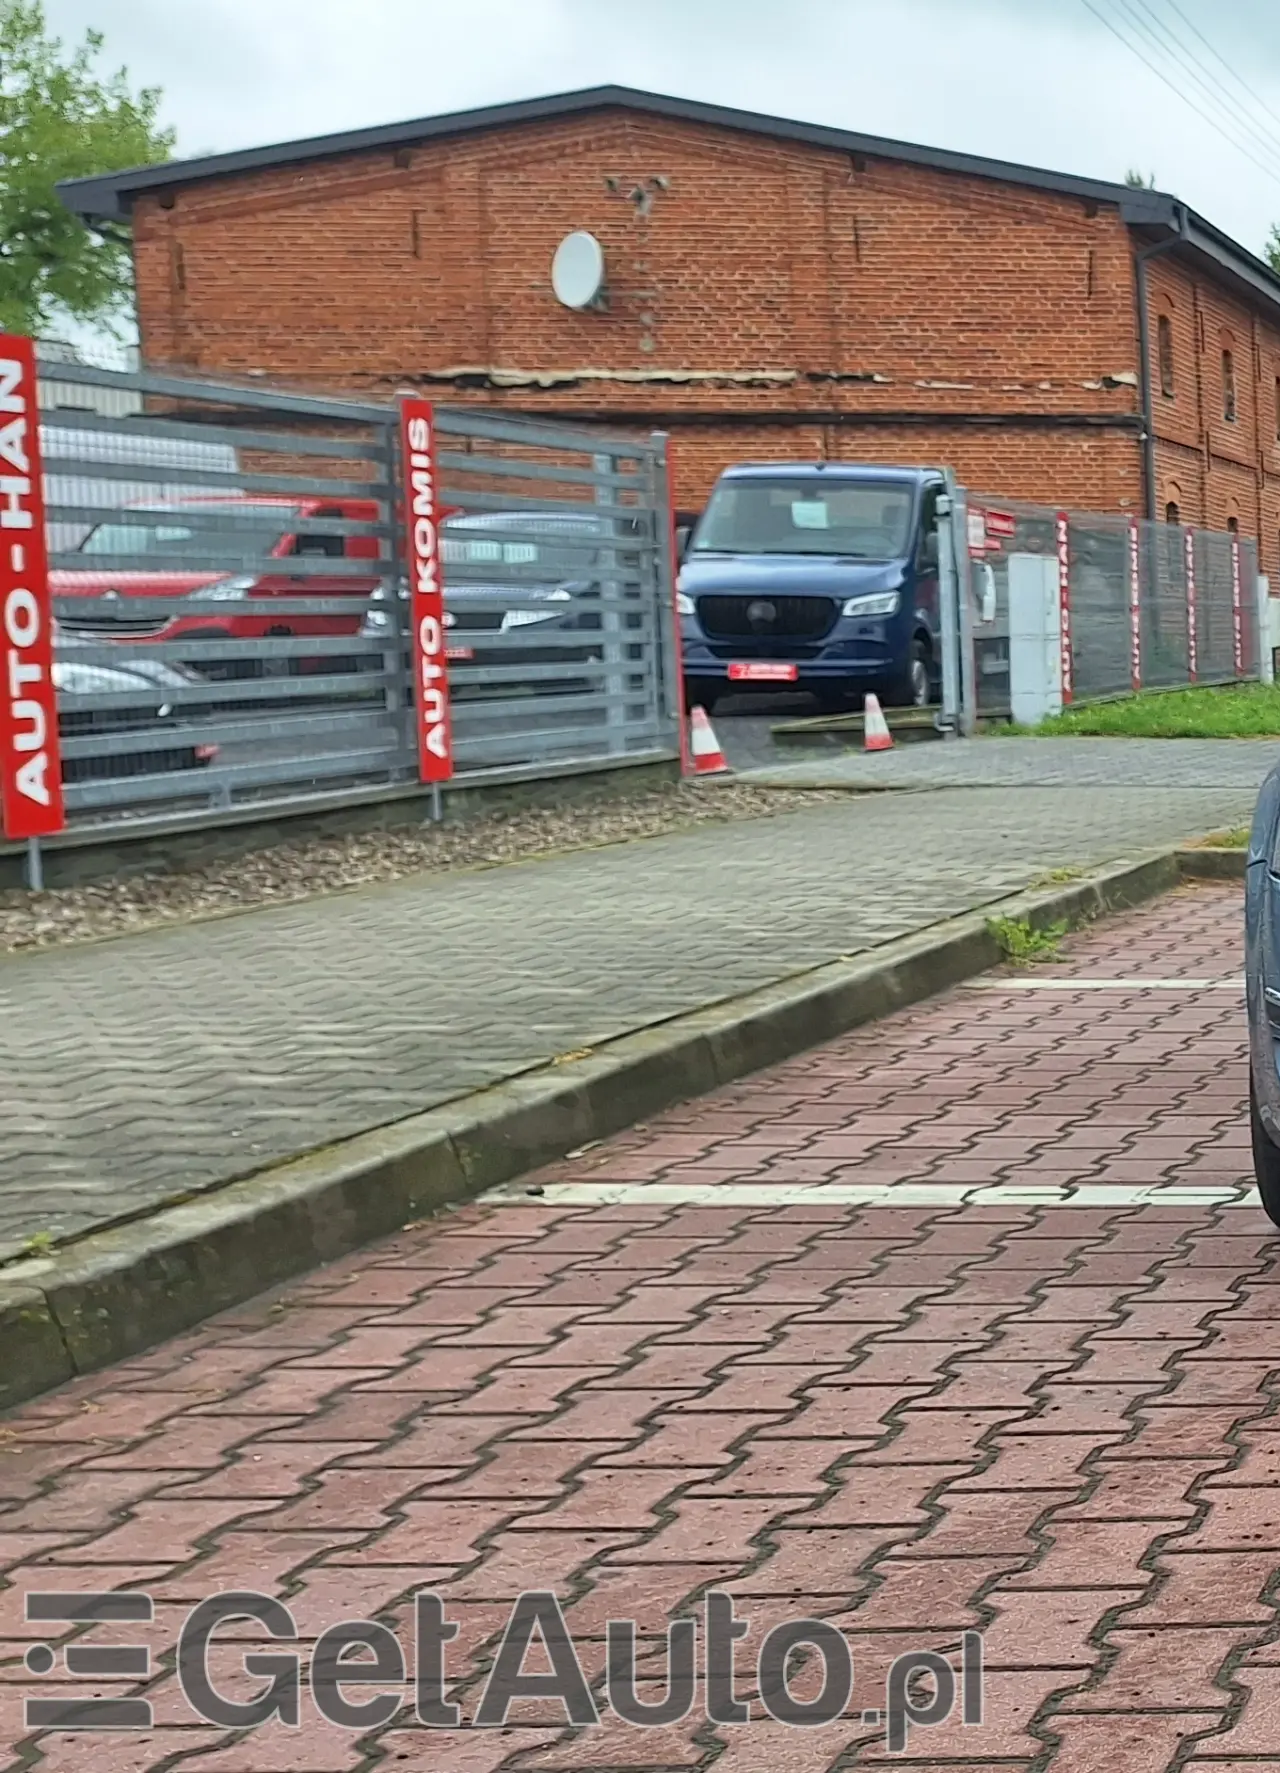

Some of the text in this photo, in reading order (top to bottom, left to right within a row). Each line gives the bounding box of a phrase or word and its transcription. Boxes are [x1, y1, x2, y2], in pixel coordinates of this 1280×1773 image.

[0, 359, 33, 529] HAN
[4, 588, 50, 806] AUTO
[407, 418, 448, 758] AUTO KOMIS
